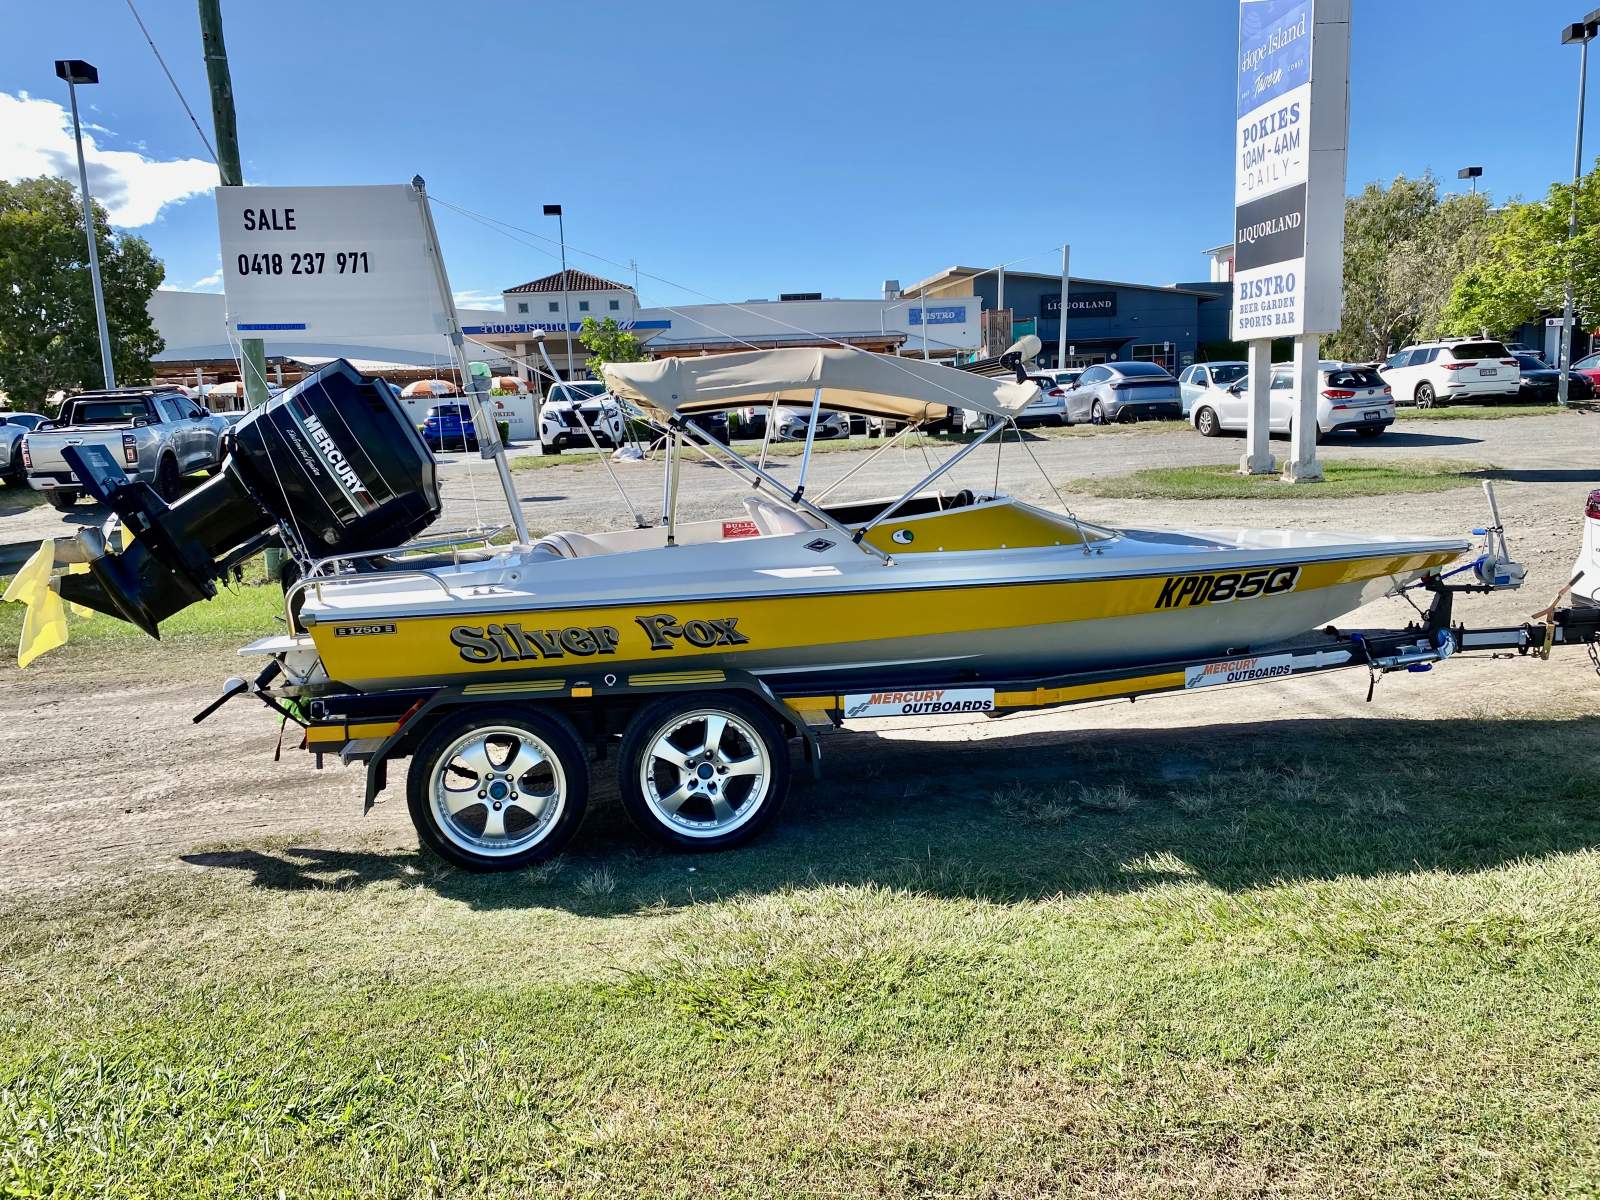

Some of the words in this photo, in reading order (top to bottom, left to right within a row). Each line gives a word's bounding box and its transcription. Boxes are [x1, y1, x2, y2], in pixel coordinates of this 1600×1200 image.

[1241, 44, 1267, 72] Hope
[1268, 12, 1306, 56] Island
[1242, 102, 1300, 148] POKIES
[243, 208, 297, 231] SALE
[1238, 212, 1301, 244] LIQUORLAND
[237, 253, 283, 275] 0418
[290, 252, 325, 275] 237
[336, 252, 369, 274] 971
[1239, 273, 1296, 301] BISTRO
[1239, 302, 1259, 314] BEER
[1261, 296, 1296, 311] GARDEN
[480, 321, 520, 335] Hope
[1239, 314, 1273, 329] SPORTS
[1275, 311, 1295, 326] BAR
[303, 414, 367, 494] MERCURY
[1154, 566, 1302, 608] KPD85Q
[449, 623, 619, 663] Silver
[635, 613, 752, 651] Fox
[1203, 658, 1259, 676] MERCURY
[1226, 664, 1291, 682] OUTBOARDS
[868, 689, 945, 705] MERCURY
[901, 700, 993, 714] OUTBOARDS
